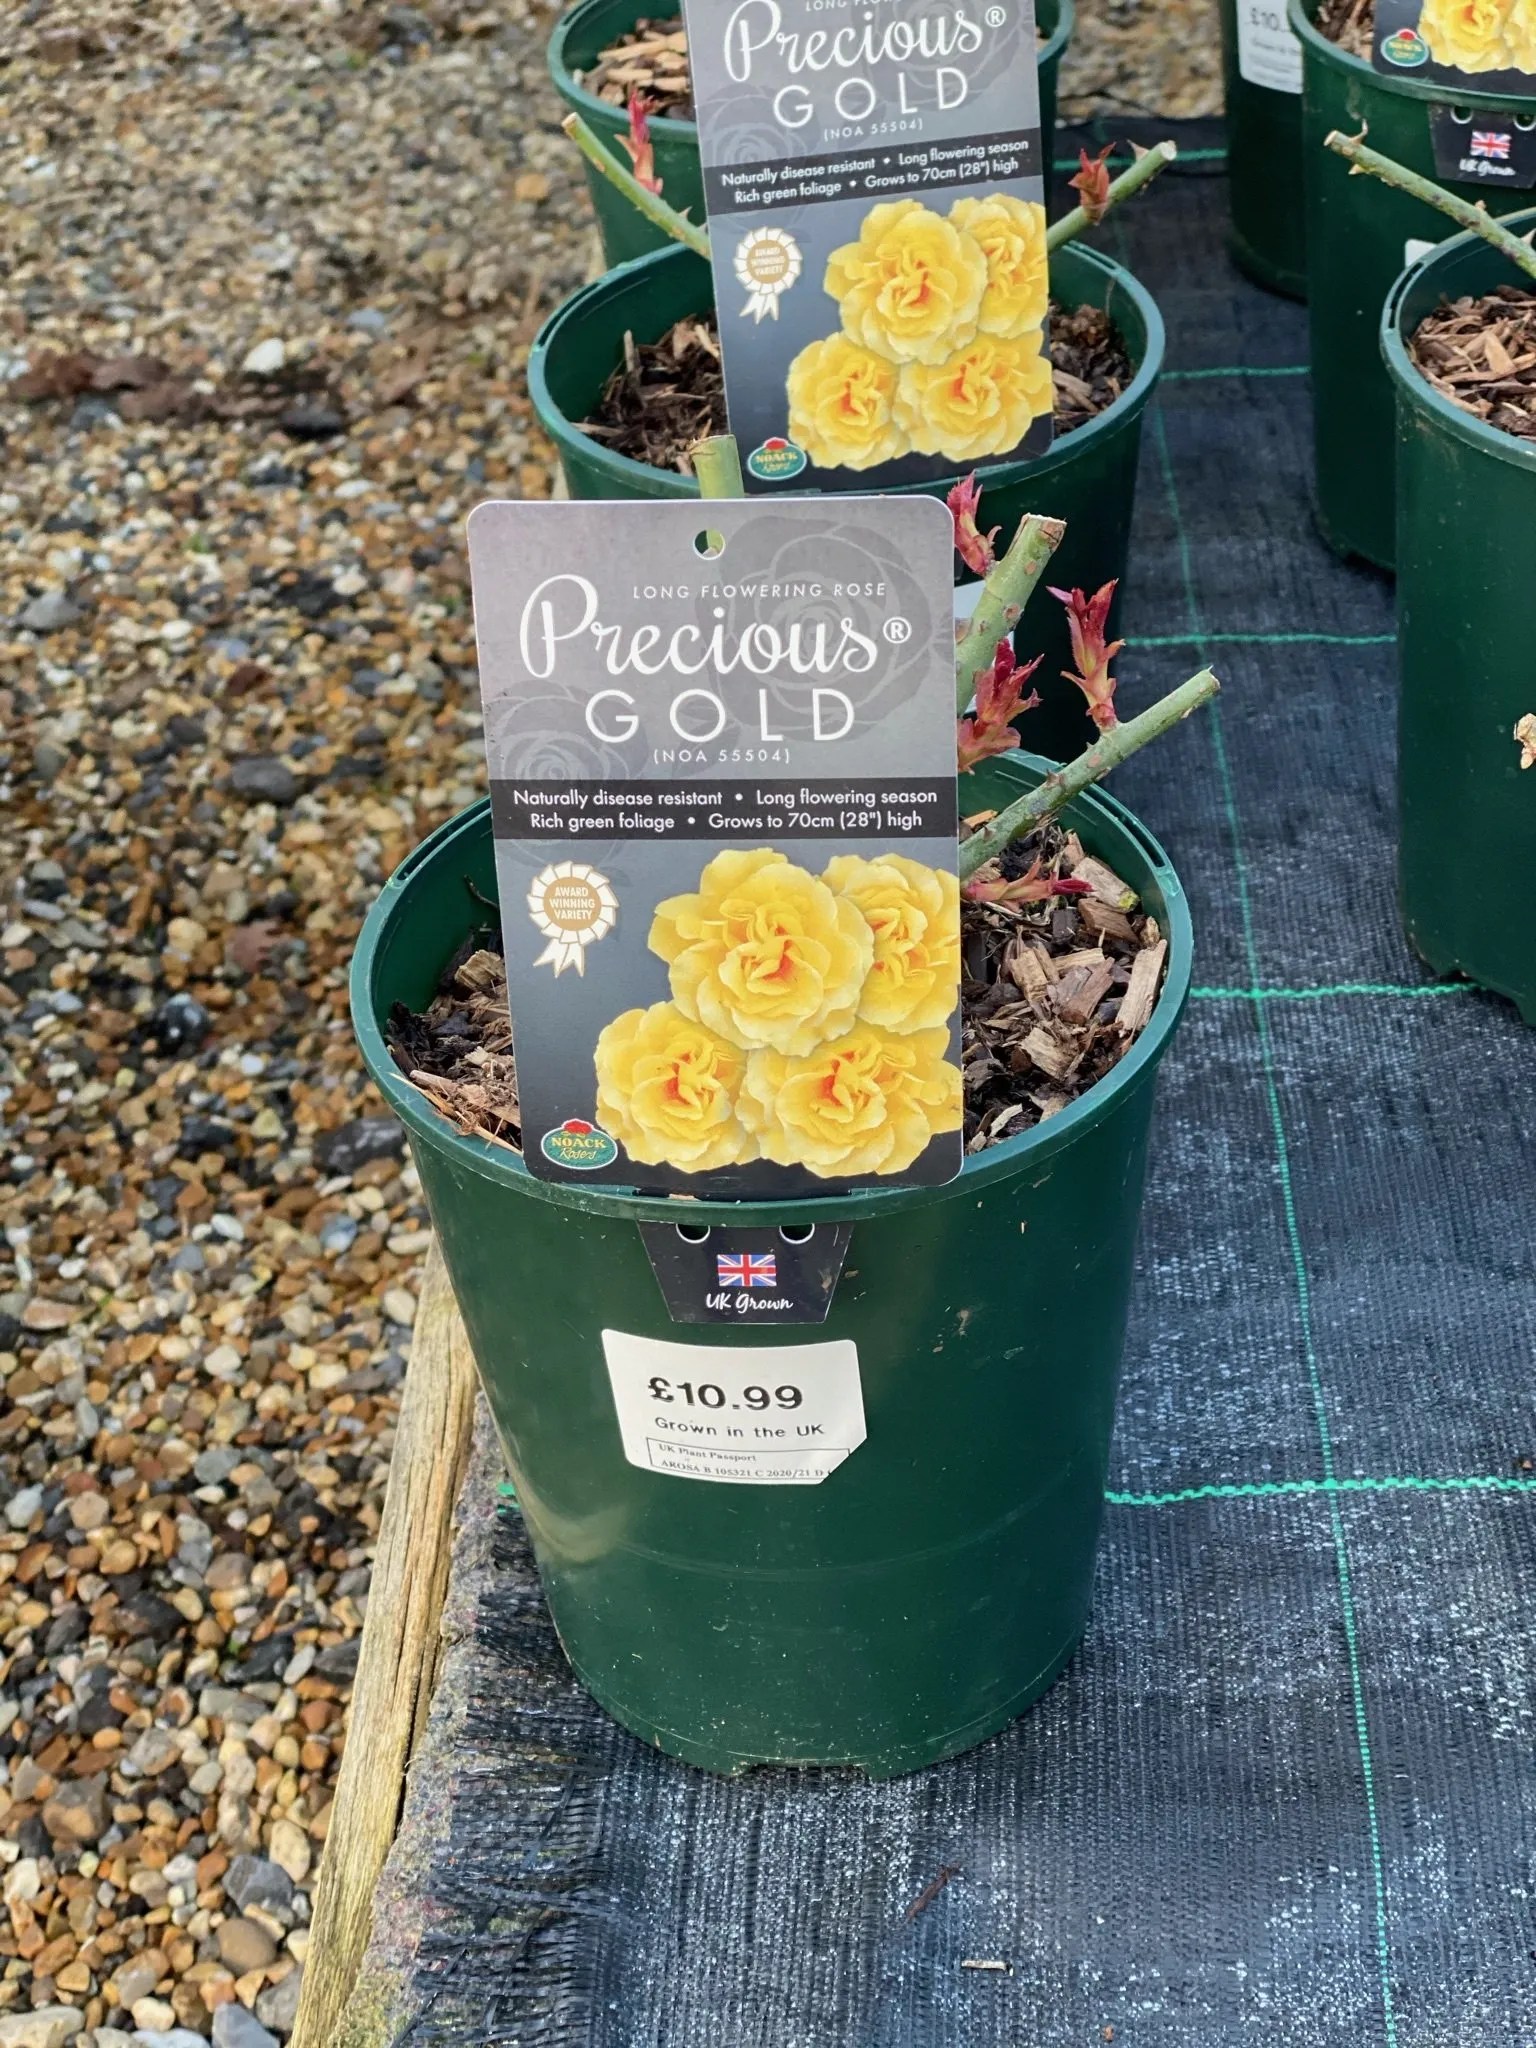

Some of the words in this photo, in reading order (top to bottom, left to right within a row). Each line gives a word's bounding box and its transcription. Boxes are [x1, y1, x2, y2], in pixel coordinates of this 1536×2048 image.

[773, 67, 968, 128] GOLD
[722, 168, 778, 186] Naturally
[780, 164, 825, 180] disease
[828, 157, 876, 174] resistant
[898, 153, 928, 166] Long
[930, 147, 986, 162] flowering
[988, 140, 1029, 154] season
[735, 188, 760, 204] Rich
[762, 187, 798, 203] green
[799, 182, 842, 196] foliage
[864, 174, 905, 188] Grows
[907, 173, 920, 183] to
[922, 167, 957, 181] 70cm
[959, 161, 990, 178] (28")
[992, 157, 1019, 174] high
[633, 585, 690, 599] LONG
[701, 583, 823, 598] FLOWERING
[833, 582, 886, 597] ROSE
[585, 688, 856, 743] GOLD
[653, 749, 707, 765] (NOA
[718, 748, 790, 764] 55504)
[513, 789, 588, 810] Naturally
[593, 788, 653, 806] disease
[658, 790, 723, 806] resistant
[756, 789, 795, 808] Long
[800, 787, 876, 808] flowering
[881, 791, 938, 804] season
[530, 813, 564, 829] Rich
[568, 818, 615, 832] green
[619, 812, 675, 833] foliage
[708, 812, 763, 829] Grows
[767, 814, 783, 828] to
[788, 812, 835, 828] 70cm
[840, 811, 882, 830] (28")
[887, 809, 922, 831] high
[549, 897, 596, 909] WINNING
[554, 886, 589, 898] AWARD
[553, 909, 593, 921] VARIETY
[551, 1136, 606, 1149] NOACK
[705, 1292, 731, 1310] UK
[735, 1293, 794, 1314] Grown
[647, 1376, 804, 1411] £10.99
[654, 1416, 717, 1436] Grown
[726, 1425, 744, 1438] in
[754, 1426, 786, 1438] the
[796, 1423, 826, 1437] UK
[658, 1443, 676, 1454] UK
[678, 1447, 707, 1459] Plant
[709, 1452, 757, 1463] Passport
[661, 1459, 701, 1473] AROSA
[703, 1465, 712, 1474] B
[755, 1469, 765, 1478] C
[767, 1469, 811, 1479] 2020/21
[815, 1469, 824, 1477] D
